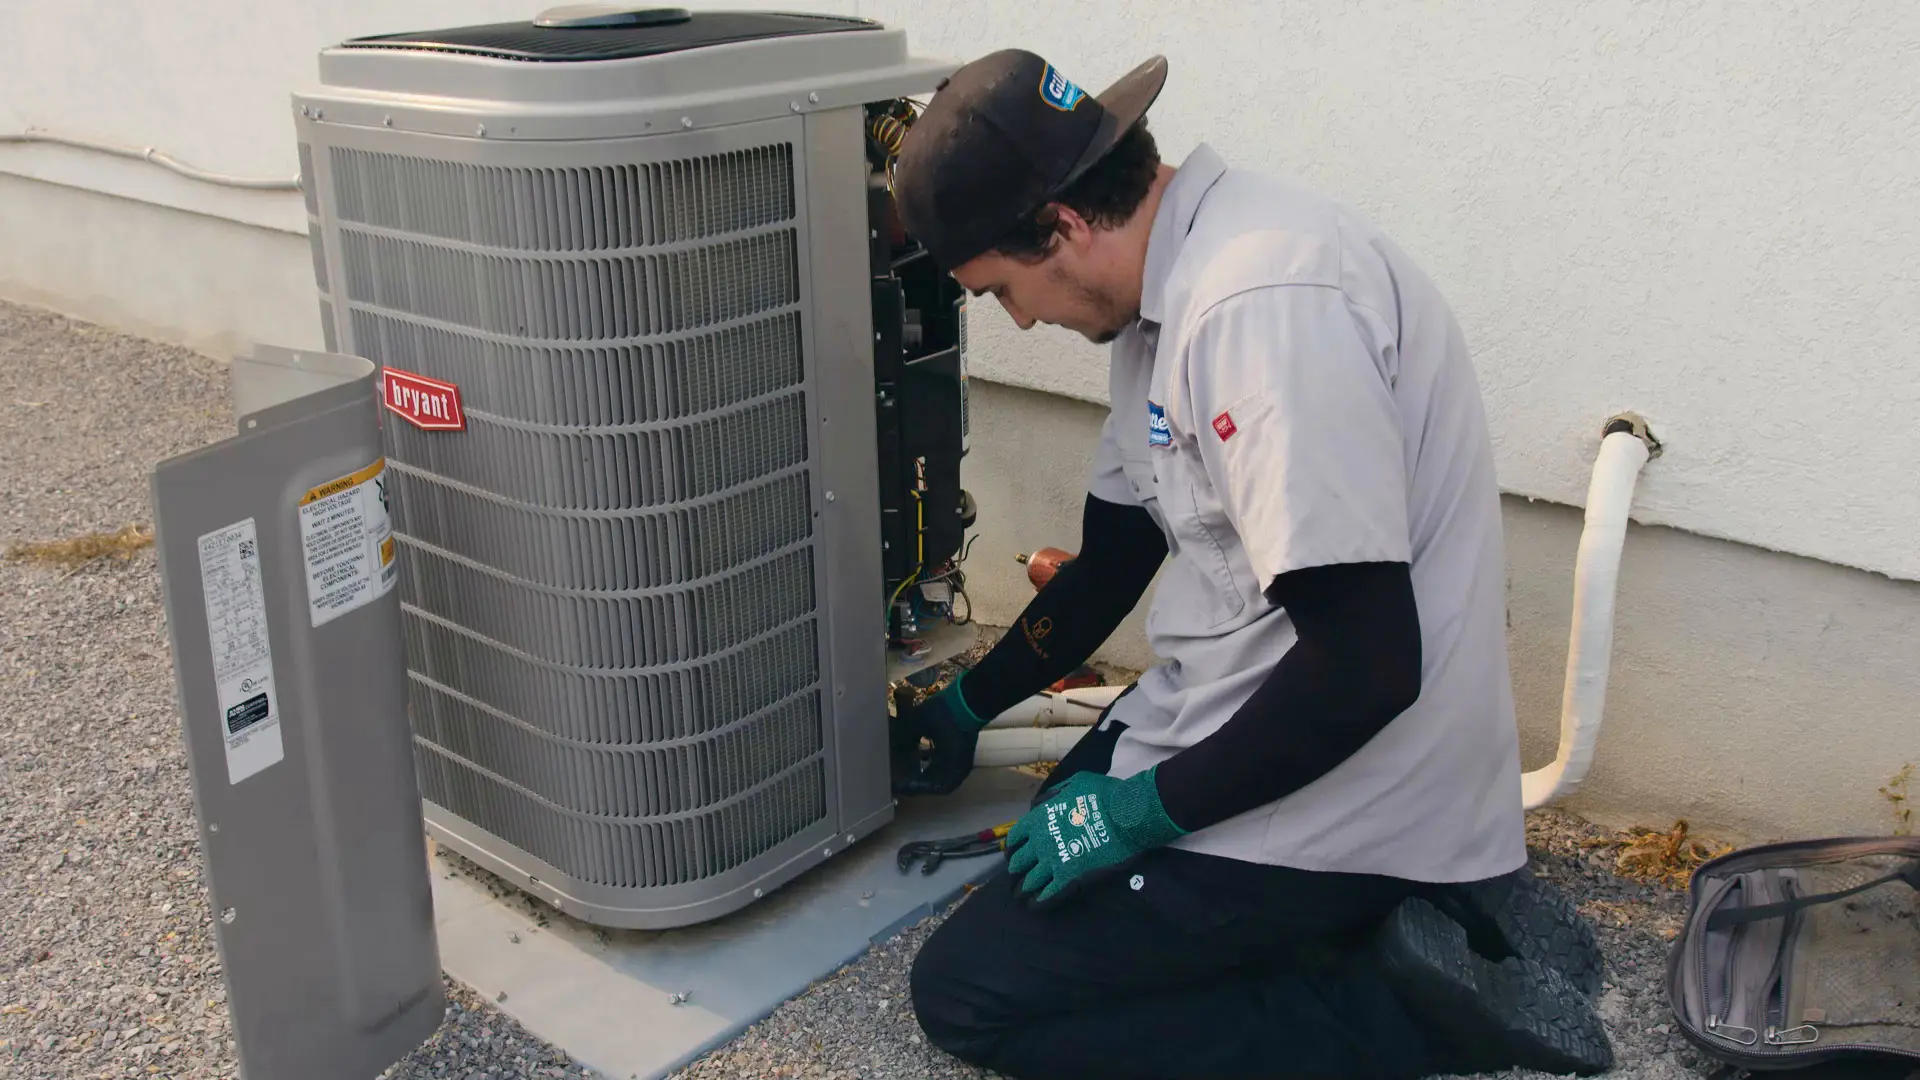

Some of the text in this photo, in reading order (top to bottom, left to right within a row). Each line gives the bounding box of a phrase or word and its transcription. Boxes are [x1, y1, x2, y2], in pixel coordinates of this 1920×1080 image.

[392, 379, 449, 420] bryant
[318, 477, 354, 497] WARNING
[302, 488, 361, 514] ELECTRICAL HAZARD
[312, 497, 352, 517] HIGH VOLTAGE
[312, 519, 326, 528] WAIT
[331, 508, 355, 521] MINUTES
[312, 553, 364, 579] BEFORE TOUCHING
[322, 565, 355, 582] ELECTRICAL
[1047, 806, 1071, 863] MaxiFlex
